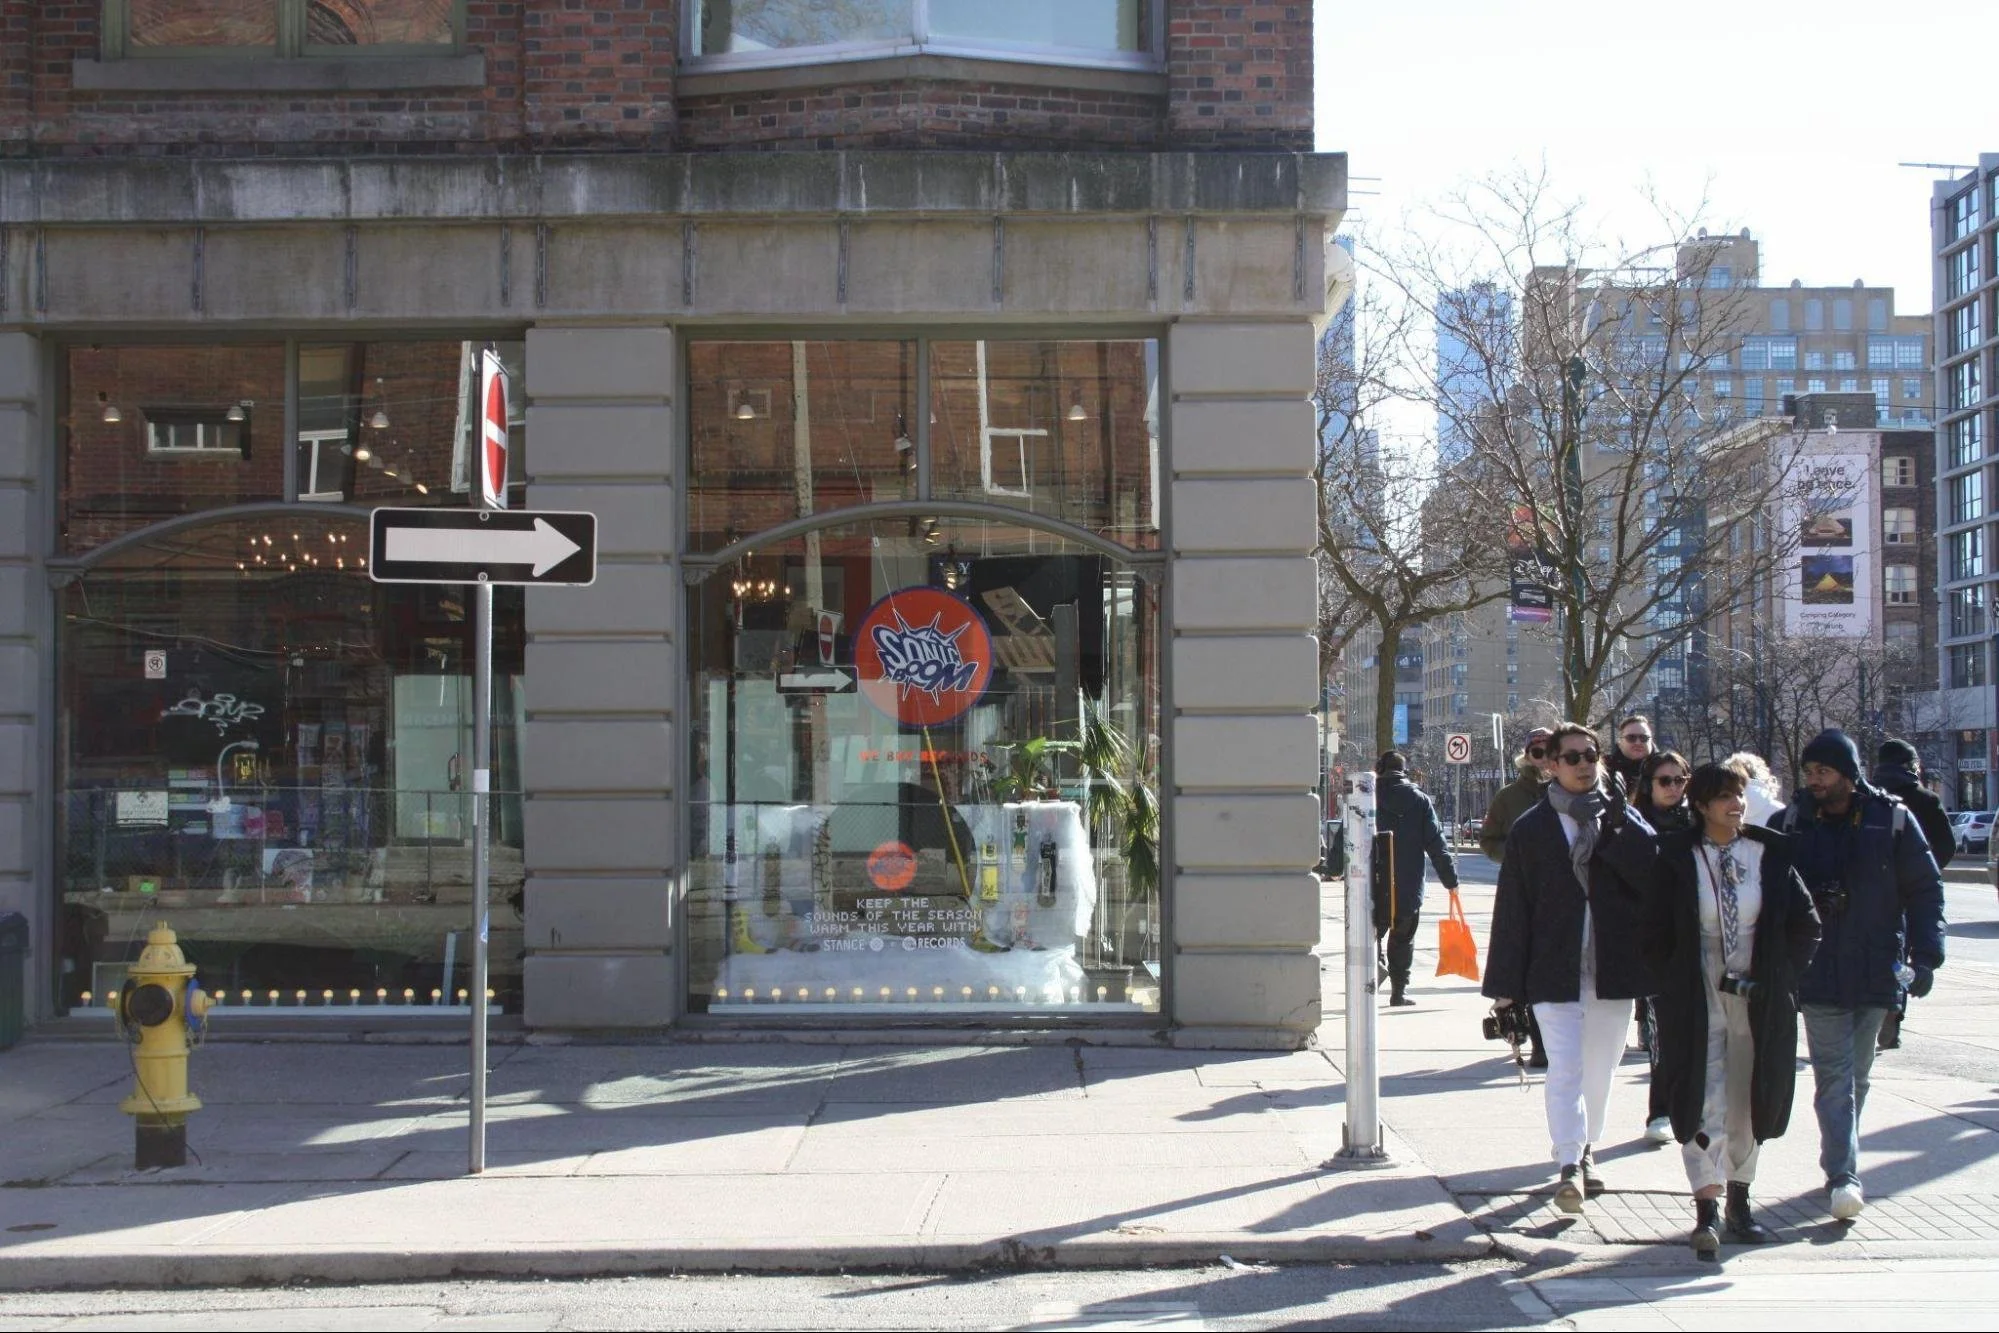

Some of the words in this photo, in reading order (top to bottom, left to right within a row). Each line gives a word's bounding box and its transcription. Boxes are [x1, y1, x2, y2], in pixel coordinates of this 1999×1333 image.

[877, 629, 961, 668] SONIC
[890, 659, 979, 693] BOOM
[860, 751, 880, 762] WE
[920, 750, 988, 763] RECDS
[856, 898, 893, 909] KEEP
[900, 897, 929, 909] THE
[804, 910, 858, 922] SOUNDS
[866, 910, 884, 921] OF
[892, 910, 919, 921] THE
[928, 909, 982, 921] SEASON
[809, 923, 850, 934] WARM
[857, 922, 889, 933] THIS
[897, 922, 934, 933] YEAR
[942, 921, 977, 933] WITH
[823, 939, 865, 952] STANCE
[917, 936, 966, 949] RECORDS
